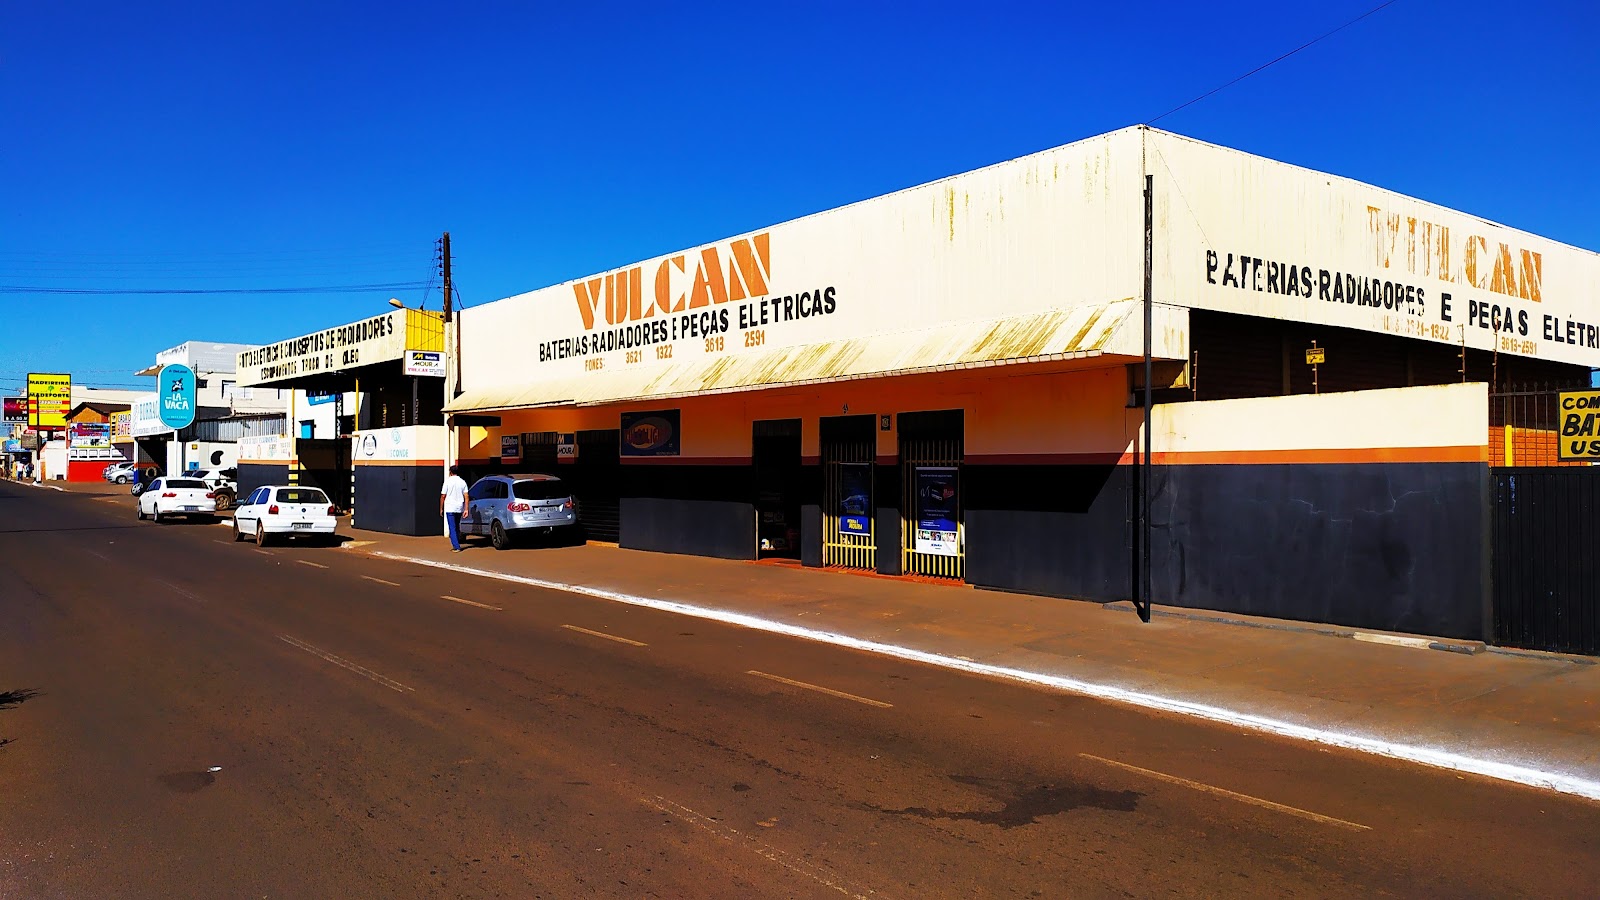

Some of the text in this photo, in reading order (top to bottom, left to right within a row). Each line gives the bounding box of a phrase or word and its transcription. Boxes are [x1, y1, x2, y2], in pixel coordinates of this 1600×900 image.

[572, 232, 771, 330] VULCAN
[672, 317, 677, 341] E
[681, 308, 729, 340] PEÇAS
[739, 286, 836, 330] ELÉTRICAS
[1441, 292, 1452, 322] E
[337, 314, 393, 347] RADIADORES
[1501, 336, 1537, 355] 3613-2591
[626, 350, 642, 364] 3621
[656, 344, 673, 360] 1322
[705, 336, 724, 353] 3613
[744, 330, 766, 347] 2591
[164, 400, 189, 410] VACA
[172, 393, 182, 401] LA
